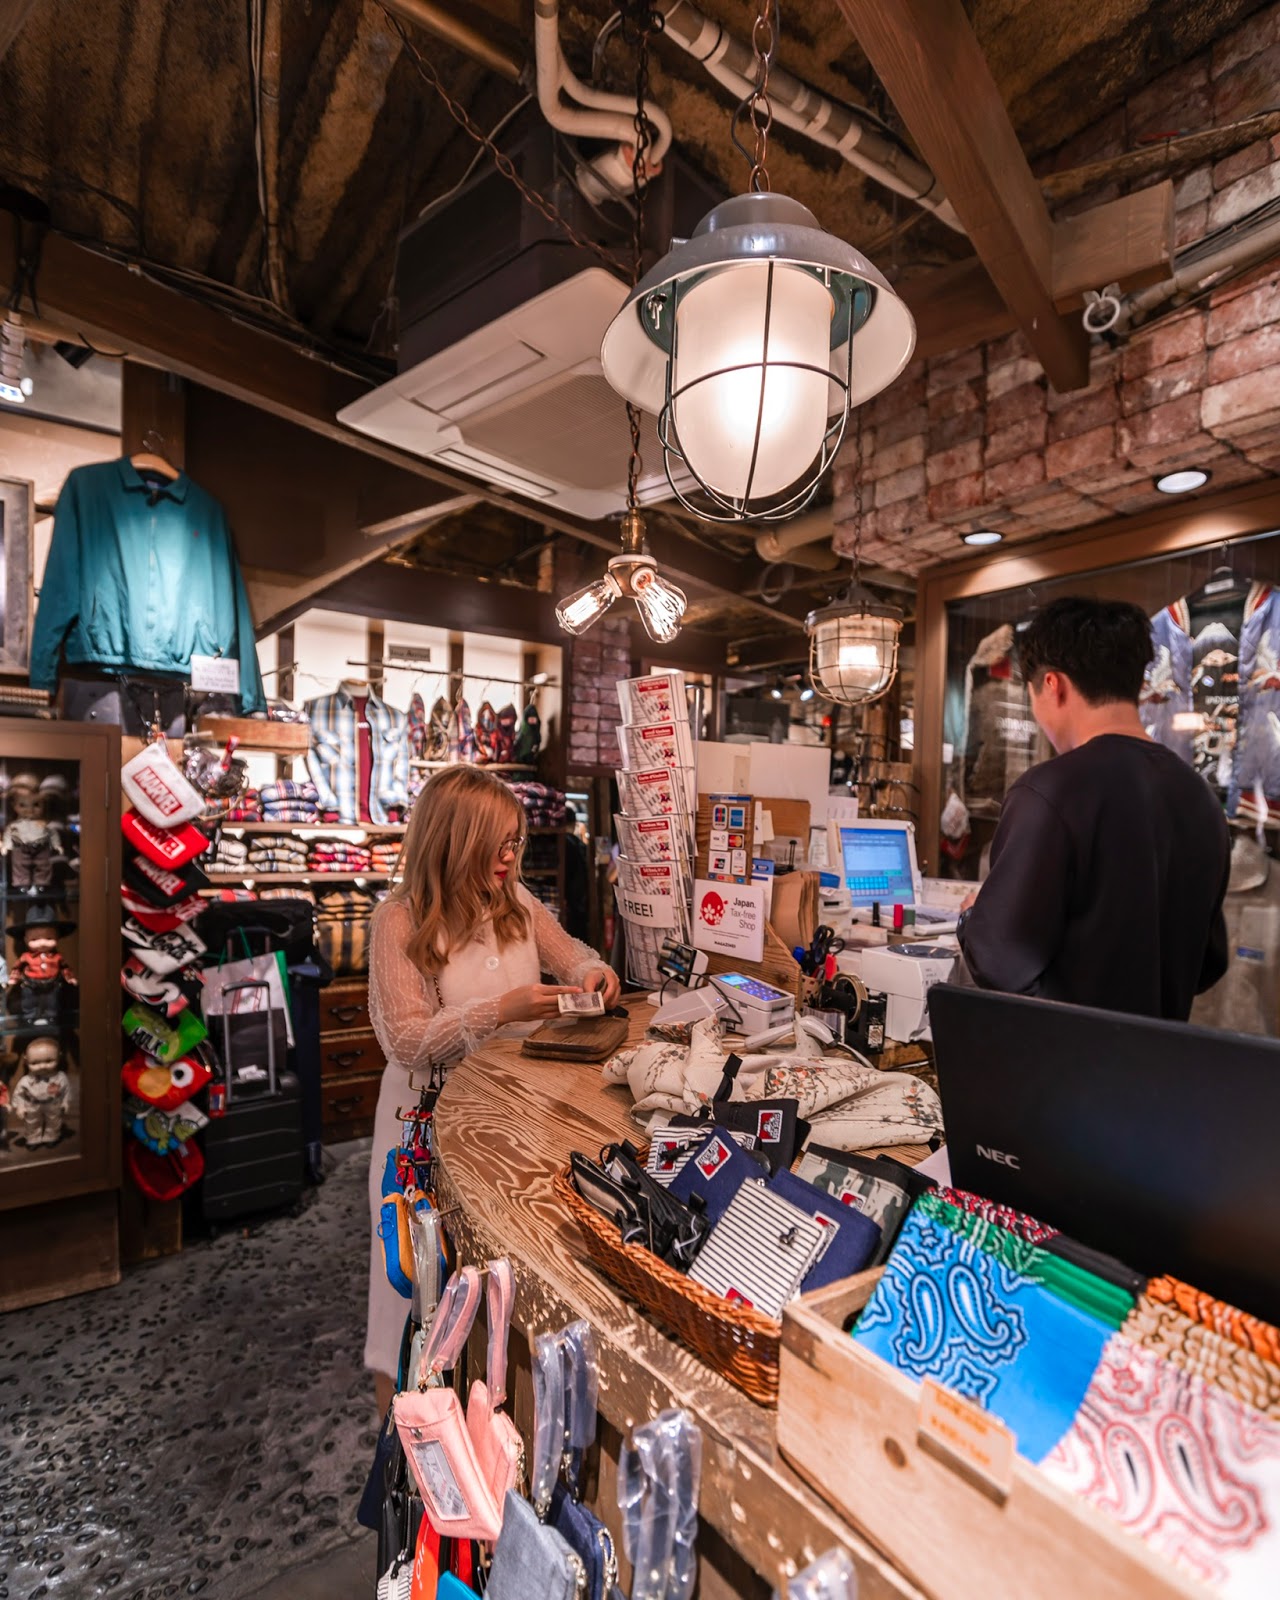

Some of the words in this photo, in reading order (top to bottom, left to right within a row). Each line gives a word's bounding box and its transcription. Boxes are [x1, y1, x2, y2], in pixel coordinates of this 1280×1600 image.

[134, 767, 181, 815] MARVEL
[624, 899, 653, 917] FREE!
[733, 897, 756, 908] Japan.
[731, 908, 756, 920] Tax-free
[739, 919, 756, 931] Shop
[976, 1144, 1021, 1170] NEC
